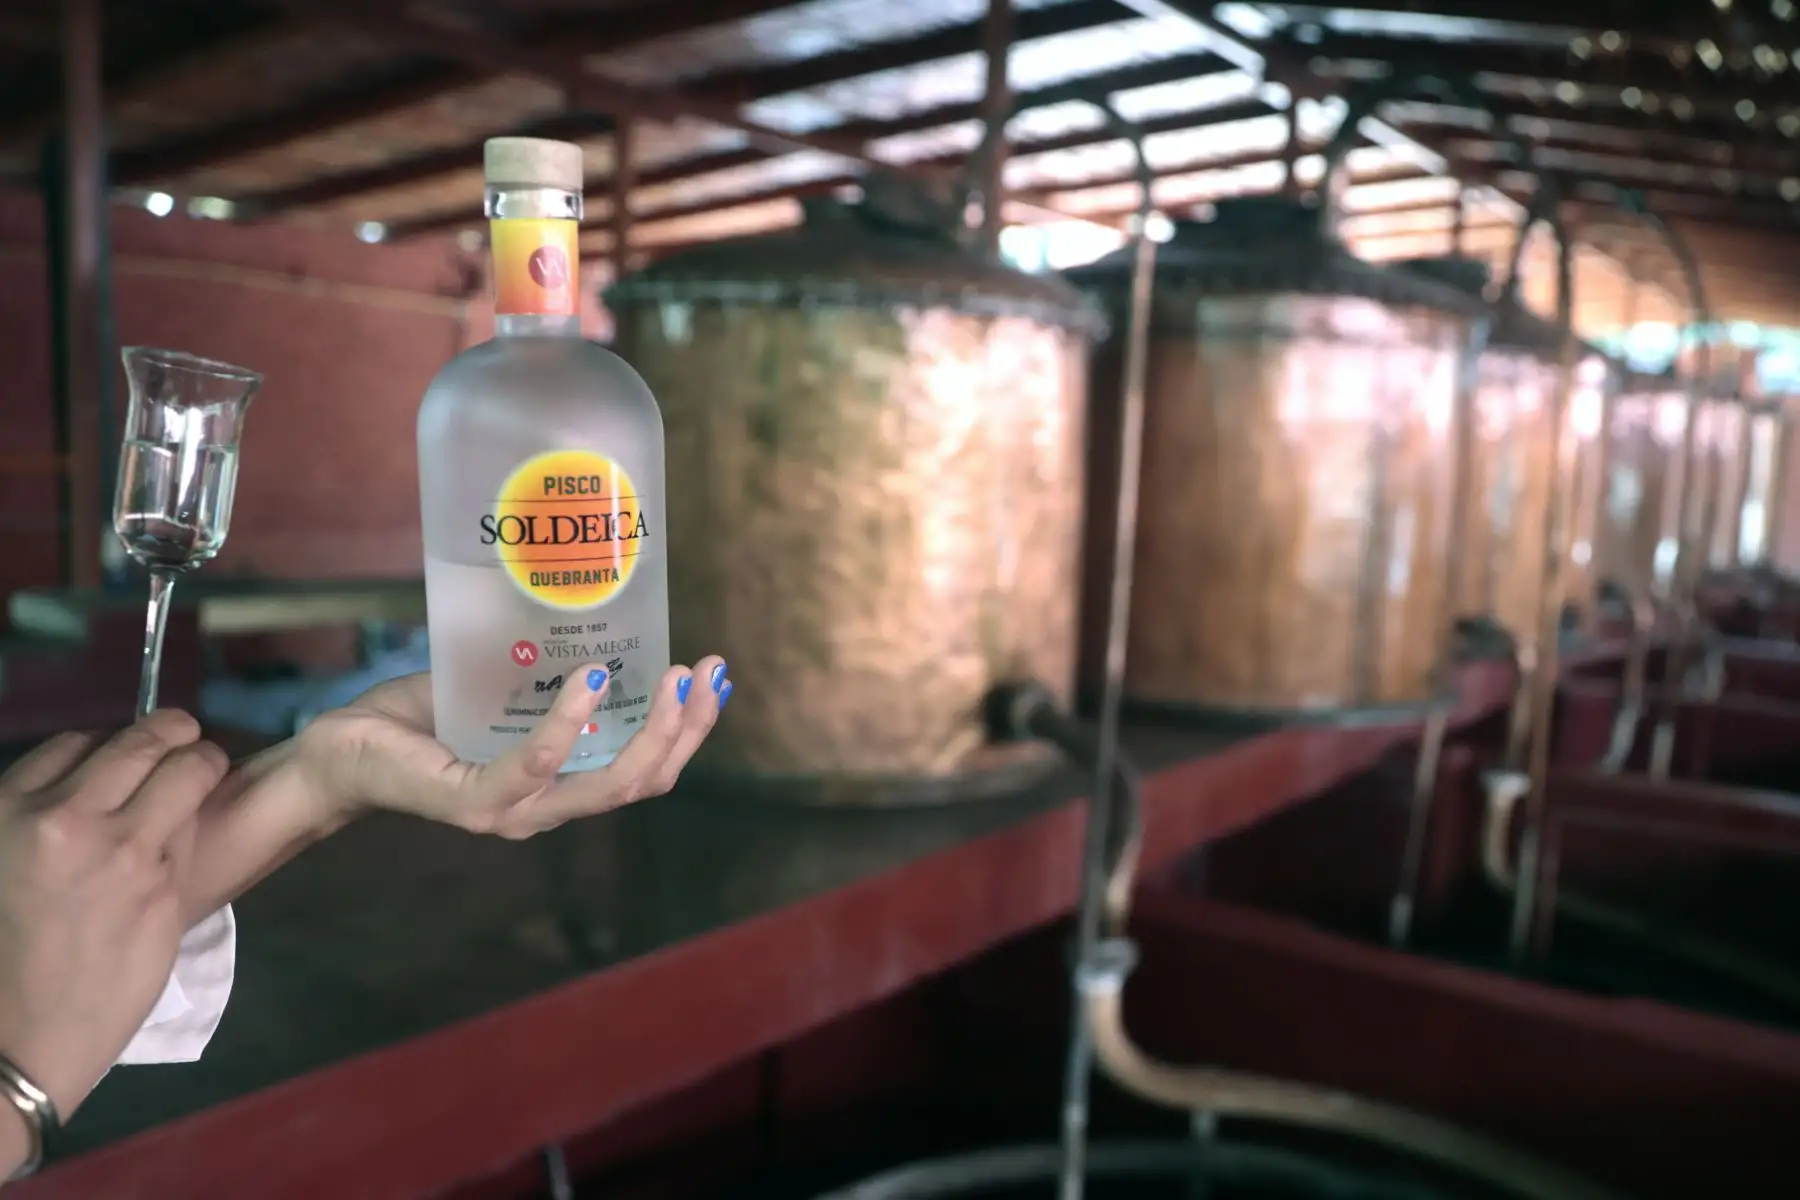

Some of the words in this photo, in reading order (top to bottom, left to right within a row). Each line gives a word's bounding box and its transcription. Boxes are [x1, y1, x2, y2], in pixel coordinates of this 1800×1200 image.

[543, 475, 601, 496] PISCO
[479, 510, 650, 546] SOLDEICA
[529, 568, 620, 587] QUEBRANTA
[550, 625, 583, 635] DESDE
[587, 623, 608, 633] 1857
[544, 643, 590, 659] VISTA
[592, 636, 640, 656] ALEGRE
